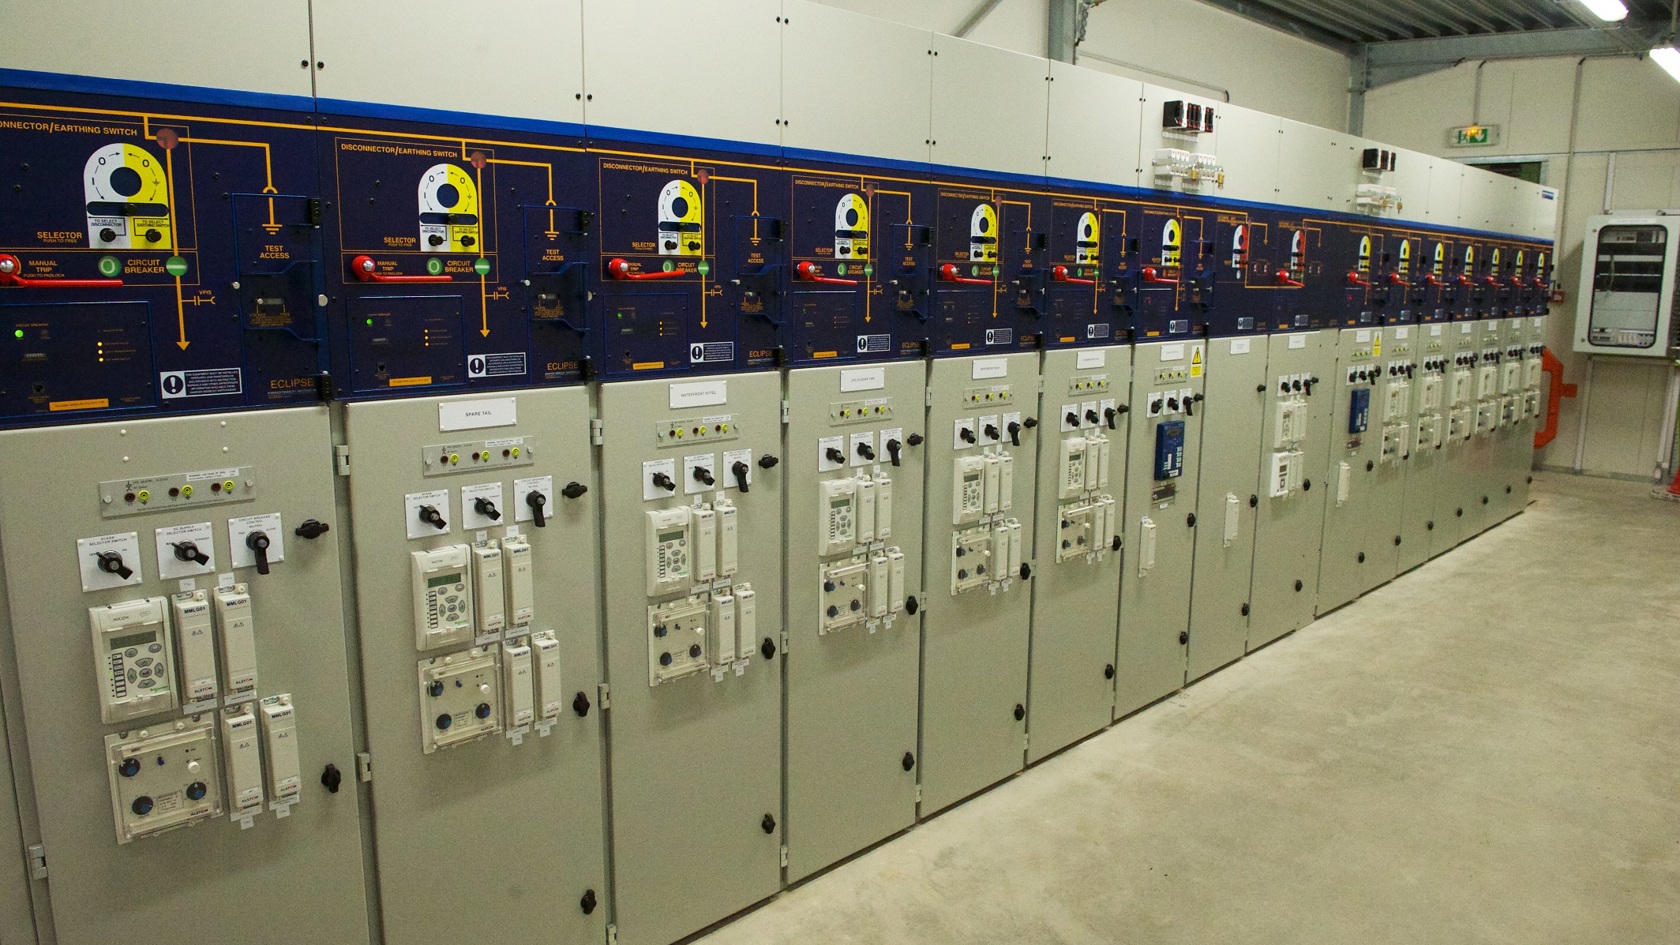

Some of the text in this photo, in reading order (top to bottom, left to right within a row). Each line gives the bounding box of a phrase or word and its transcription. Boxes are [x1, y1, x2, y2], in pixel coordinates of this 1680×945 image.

[103, 126, 138, 136] SWITCH
[340, 143, 458, 158] DISCONNECTOR/EARTHING SWITCH
[603, 162, 670, 173] DISCONNECTOR/EARTHING
[36, 231, 83, 240] SELECTOR
[546, 362, 579, 371] ECLIPSE
[270, 378, 315, 389] ECLIPSE
